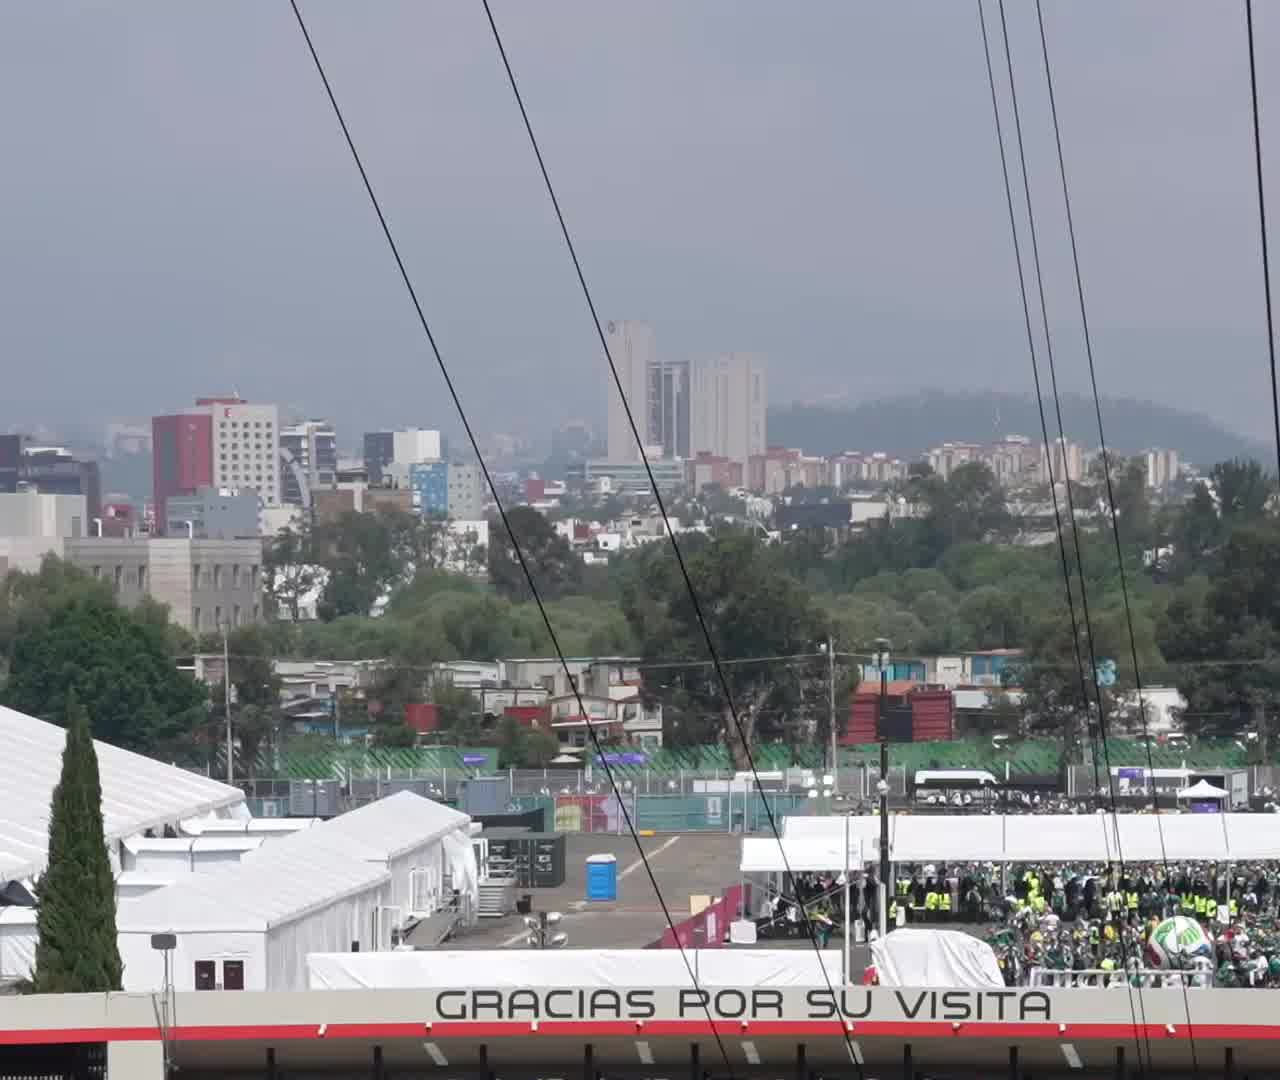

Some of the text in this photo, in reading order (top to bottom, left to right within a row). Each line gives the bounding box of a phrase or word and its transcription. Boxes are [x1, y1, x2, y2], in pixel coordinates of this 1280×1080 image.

[435, 990, 1052, 1020] GRACIAS POR SU VISITA
